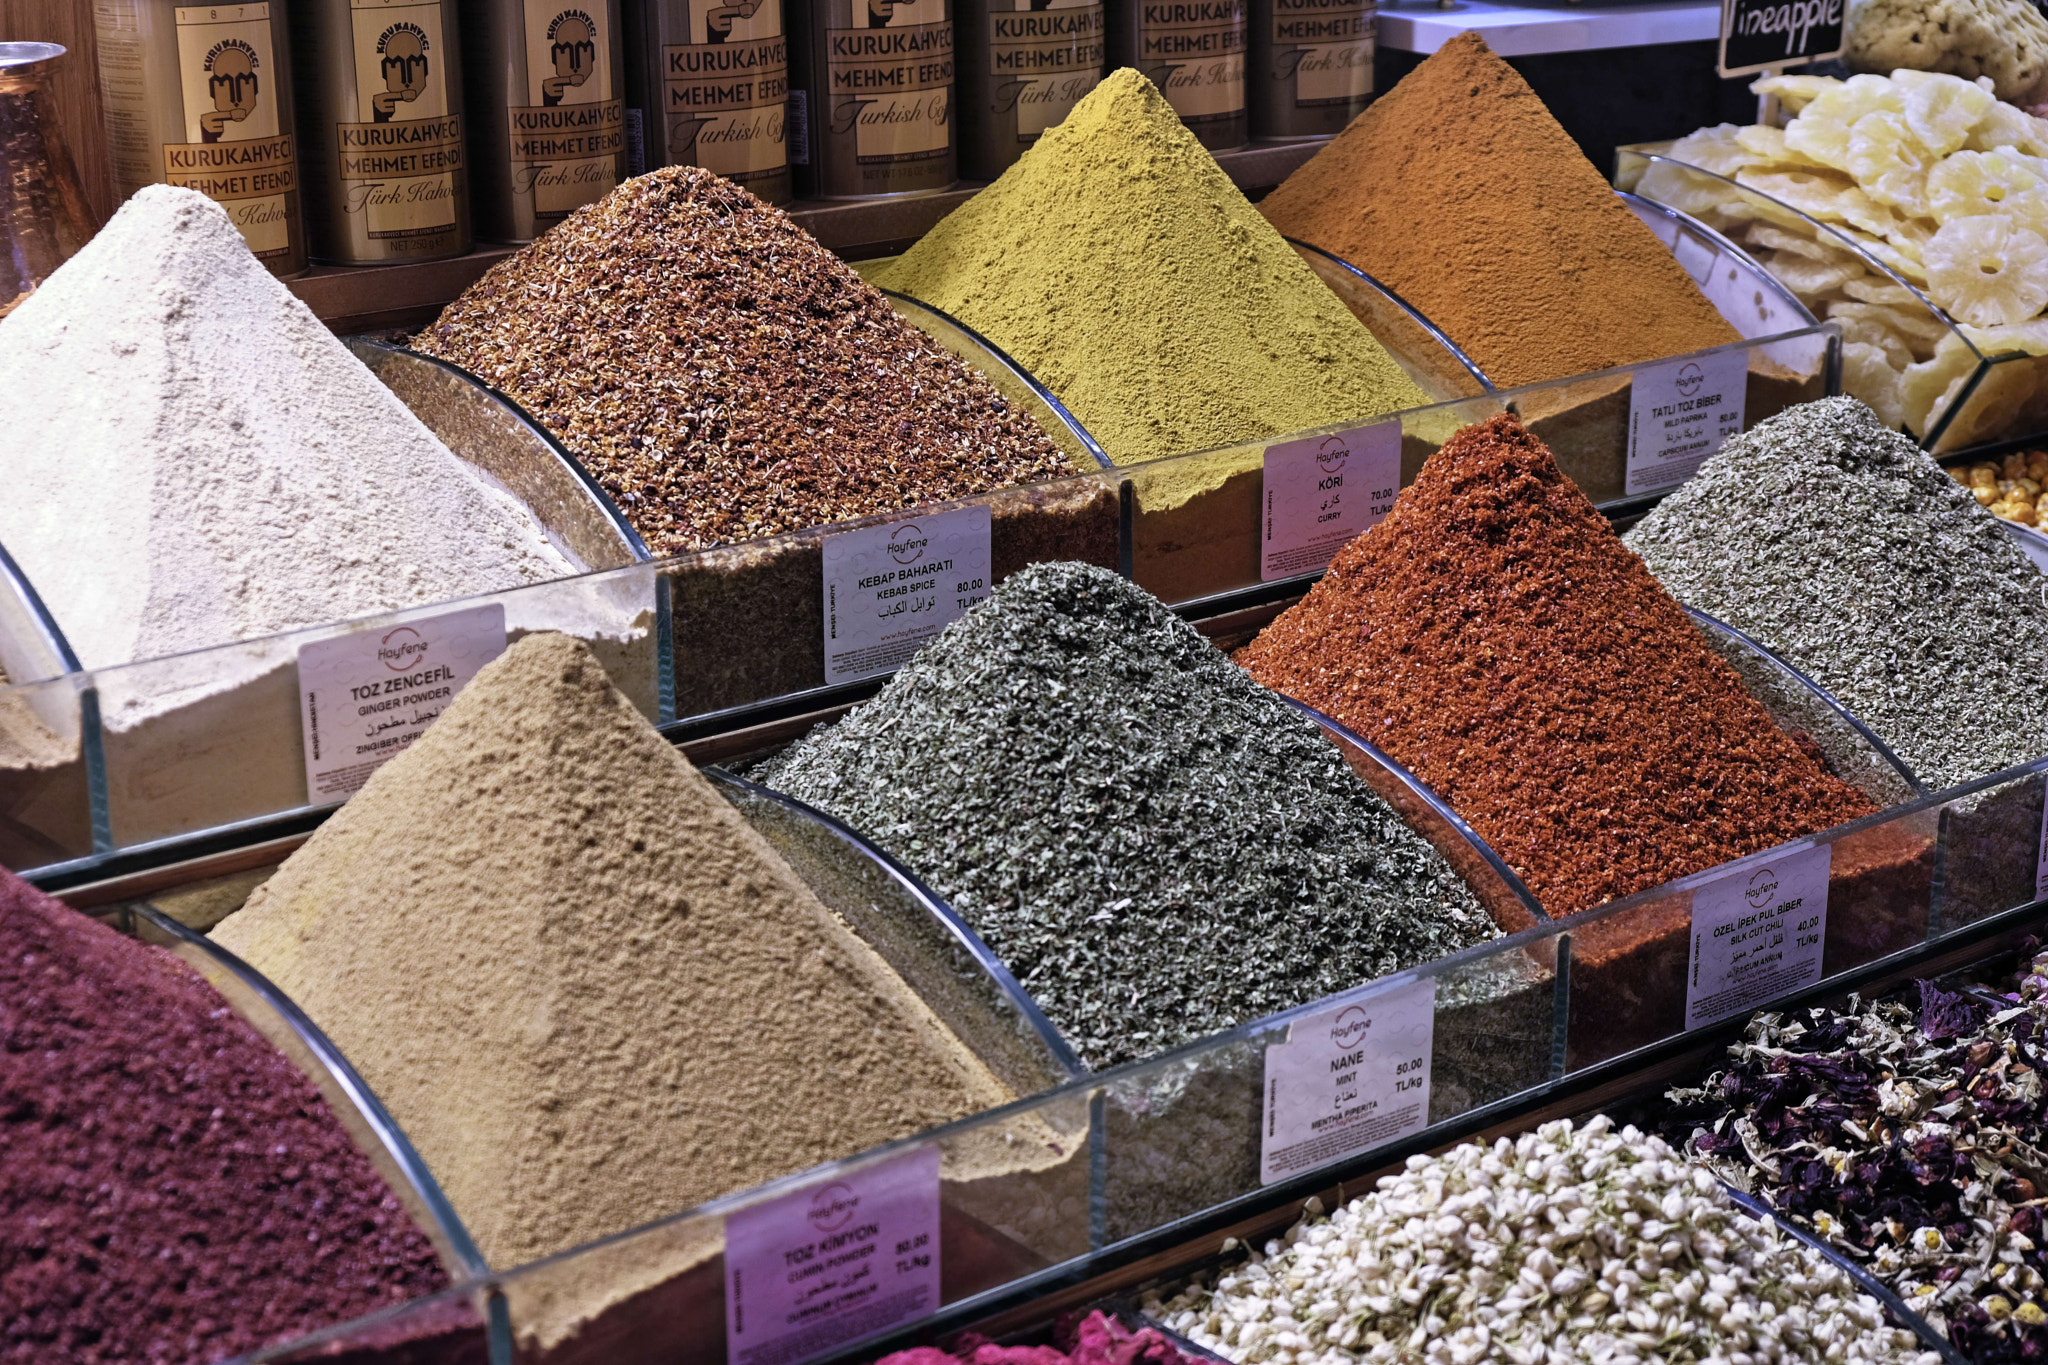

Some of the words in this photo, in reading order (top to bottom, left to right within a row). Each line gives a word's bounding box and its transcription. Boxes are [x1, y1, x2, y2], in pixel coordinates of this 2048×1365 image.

[1277, 19, 1349, 37] MEHMET
[1145, 33, 1218, 53] MEHMET
[996, 48, 1072, 68] MEHMET
[834, 67, 914, 88] MEHMET
[672, 83, 753, 106] MEHMET
[991, 79, 1056, 114] Türk
[829, 99, 925, 135] Turkish
[344, 117, 459, 146] KURUKAHVECİ
[668, 116, 762, 154] Turkish
[170, 137, 291, 167] KURUKAHVECİ
[515, 138, 583, 155] MEHMET
[345, 155, 417, 173] MEHMET
[422, 144, 461, 169] EFENDİ
[253, 166, 294, 191] EFENDİ
[512, 165, 571, 194] Türk
[344, 184, 404, 213] Türk
[390, 240, 408, 251] NET
[1652, 404, 1676, 419] TATLI
[1678, 400, 1695, 413] TOZ
[1696, 394, 1722, 409] BİBER
[1316, 449, 1350, 464] Hayfene
[1319, 473, 1343, 491] KÖRİ
[1371, 488, 1393, 501] 70.00
[1317, 511, 1341, 523] CURRY
[887, 538, 928, 554] Hayfene
[858, 572, 895, 590] KEBAP
[898, 559, 953, 581] BAHARATI
[877, 585, 907, 600] KEBAB
[910, 579, 936, 593] SPICE
[957, 578, 983, 593] 80.00
[881, 624, 936, 641] www.hayfene.com
[377, 641, 428, 661] Hayfene
[350, 683, 380, 700] TOZ
[384, 664, 455, 693] ZENCEFİL
[358, 698, 401, 716] GINGER
[403, 687, 450, 706] POWDER
[356, 736, 399, 754] ZINGIBER
[1745, 880, 1779, 899] Hayfene
[1713, 922, 1736, 938] ÖZEL
[1738, 914, 1757, 930] İPEK
[1759, 909, 1775, 922] PUL
[1777, 898, 1803, 916] BİBER
[1797, 916, 1819, 932] 40.00
[1731, 933, 1747, 945] SILK
[1749, 926, 1764, 939] CUT
[1765, 918, 1784, 932] CHILI
[1796, 934, 1819, 948] TL/kg
[1330, 1018, 1372, 1039] Hayfene
[1330, 1050, 1364, 1073] NANE
[1396, 1058, 1422, 1075] 50.00
[1336, 1071, 1357, 1086] MINT
[1395, 1077, 1422, 1093] TL/kg
[1311, 1112, 1343, 1130] MENTHA
[1344, 1101, 1378, 1117] PIPERITA
[785, 1244, 815, 1266] TOZ
[826, 1243, 875, 1268] POWDER
